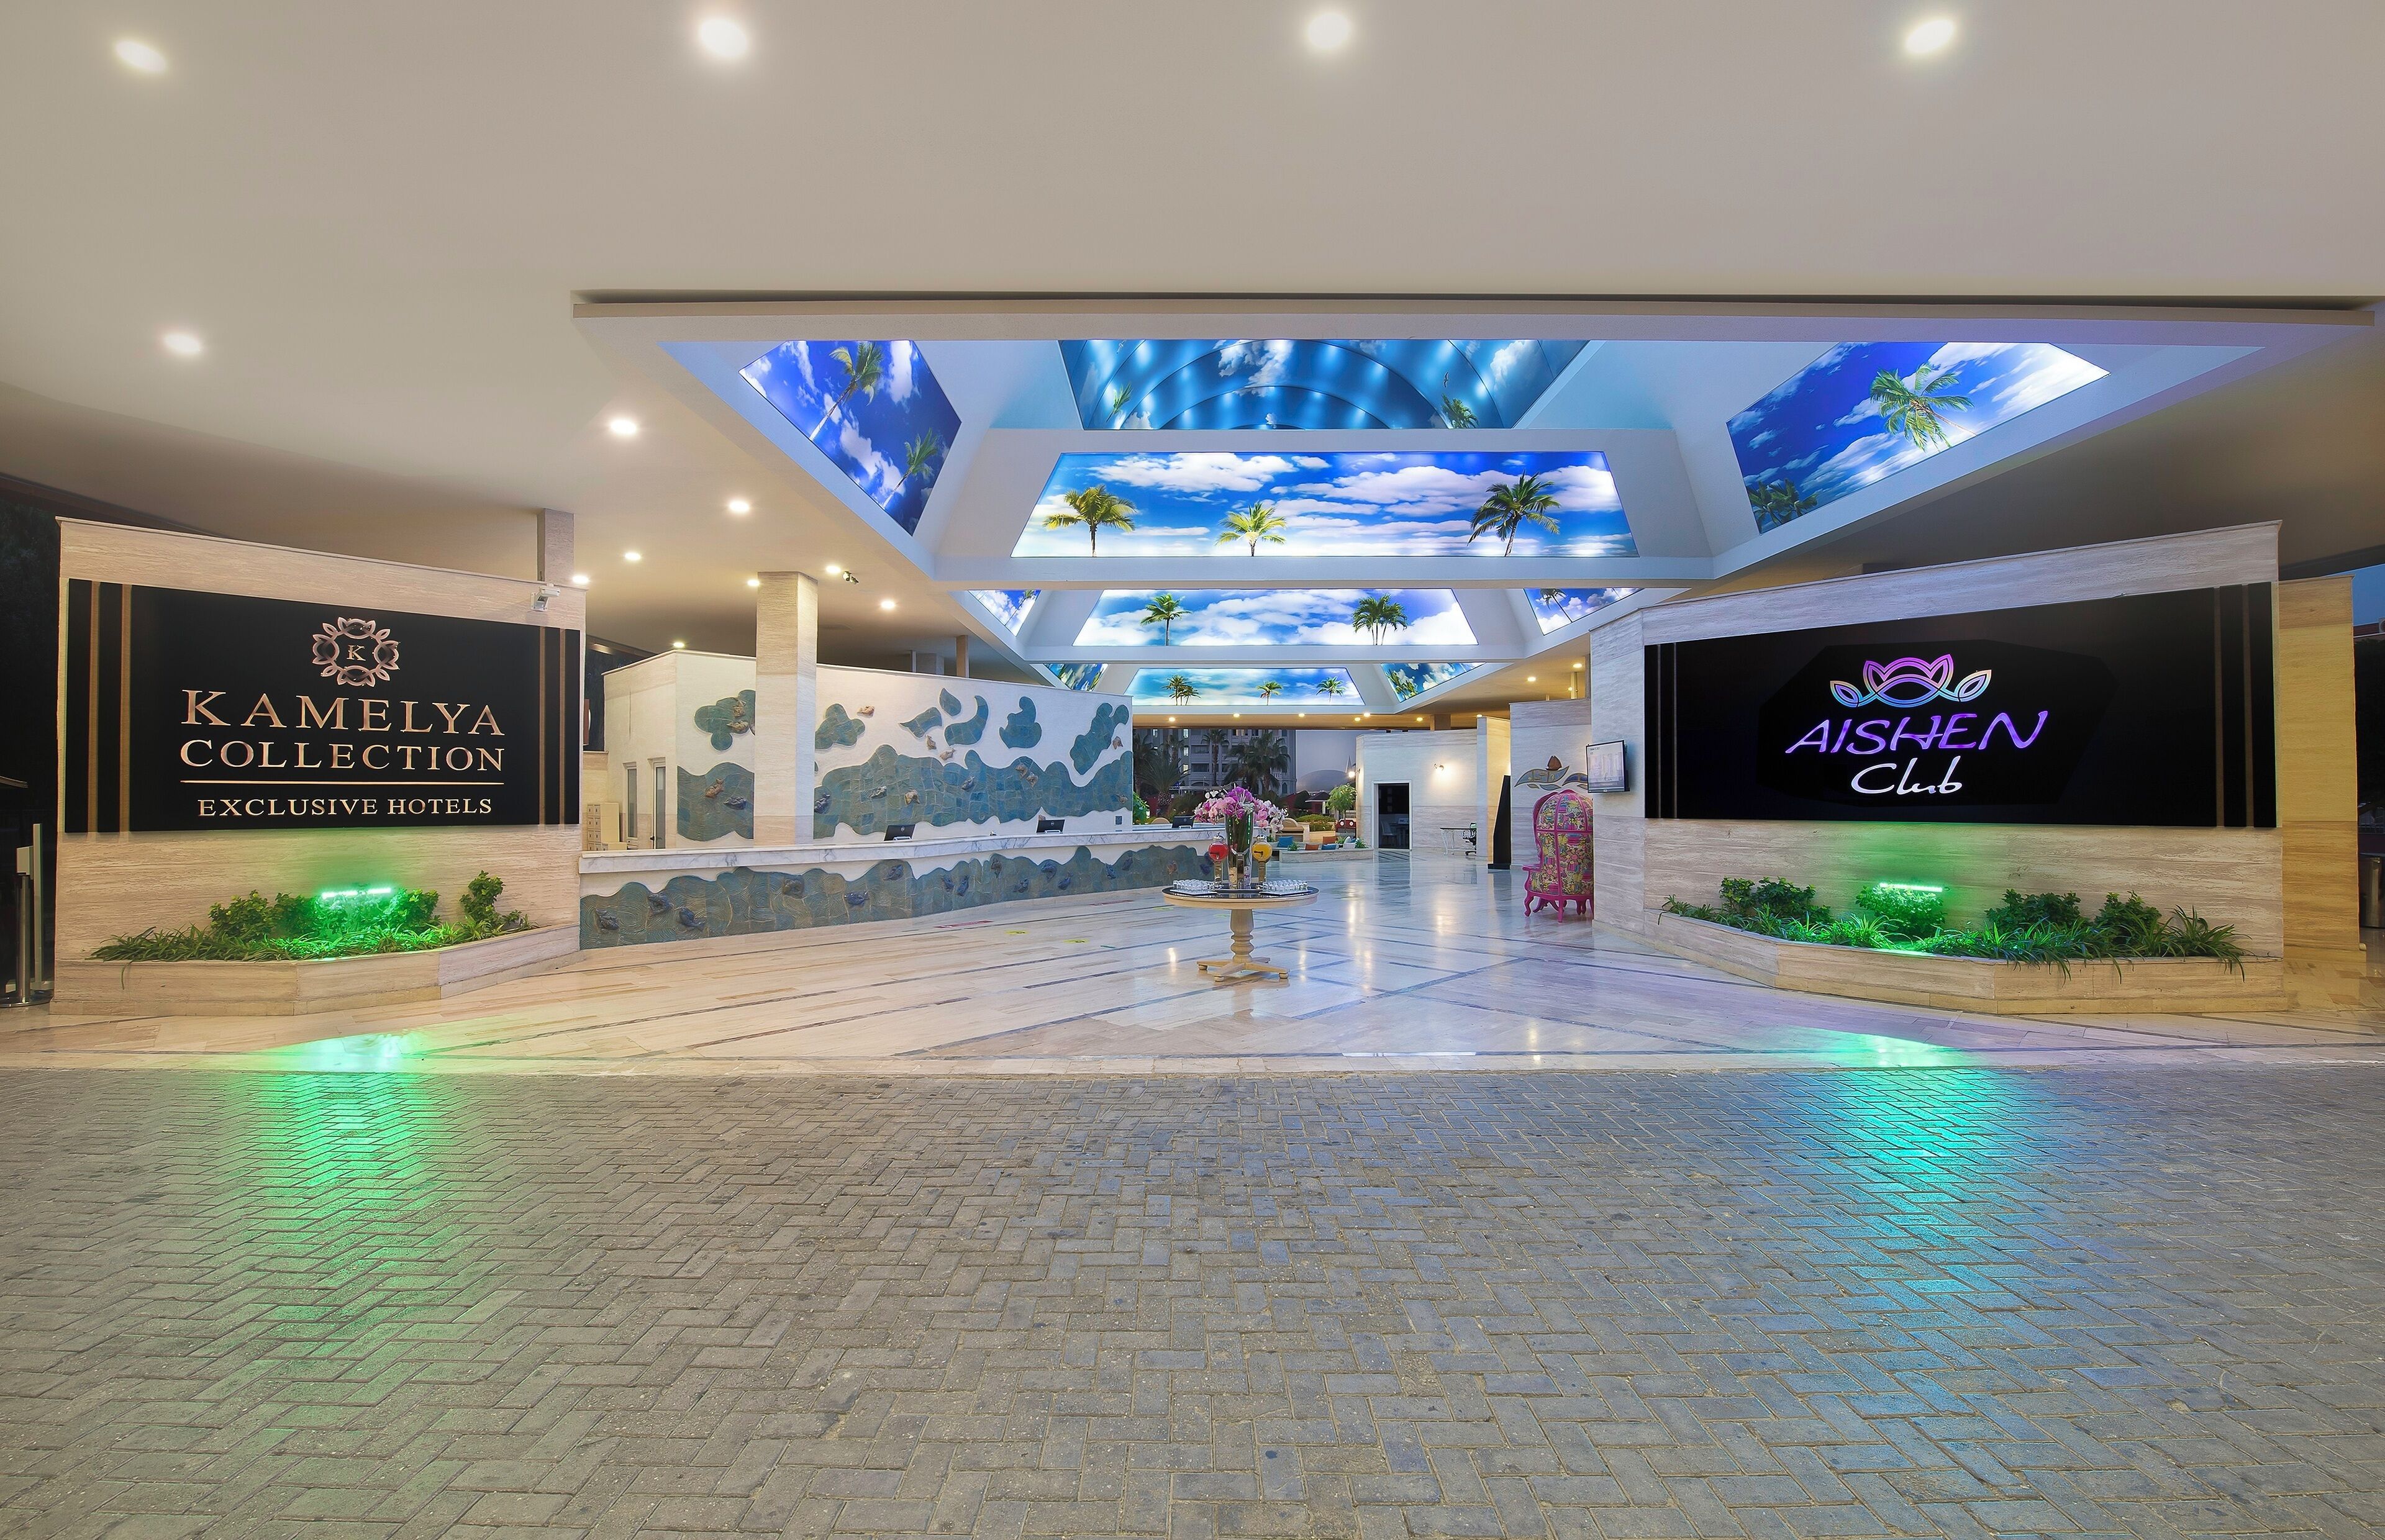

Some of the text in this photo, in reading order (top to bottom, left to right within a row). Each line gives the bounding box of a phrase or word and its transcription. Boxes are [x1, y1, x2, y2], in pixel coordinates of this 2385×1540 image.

[346, 645, 366, 661] K
[181, 689, 506, 736] KAMELYA
[1784, 710, 2049, 755] AISHEN
[180, 739, 505, 771] COLLECTION
[1851, 755, 1963, 795] Club
[197, 798, 492, 817] EXCLUSIVE HOTELS
